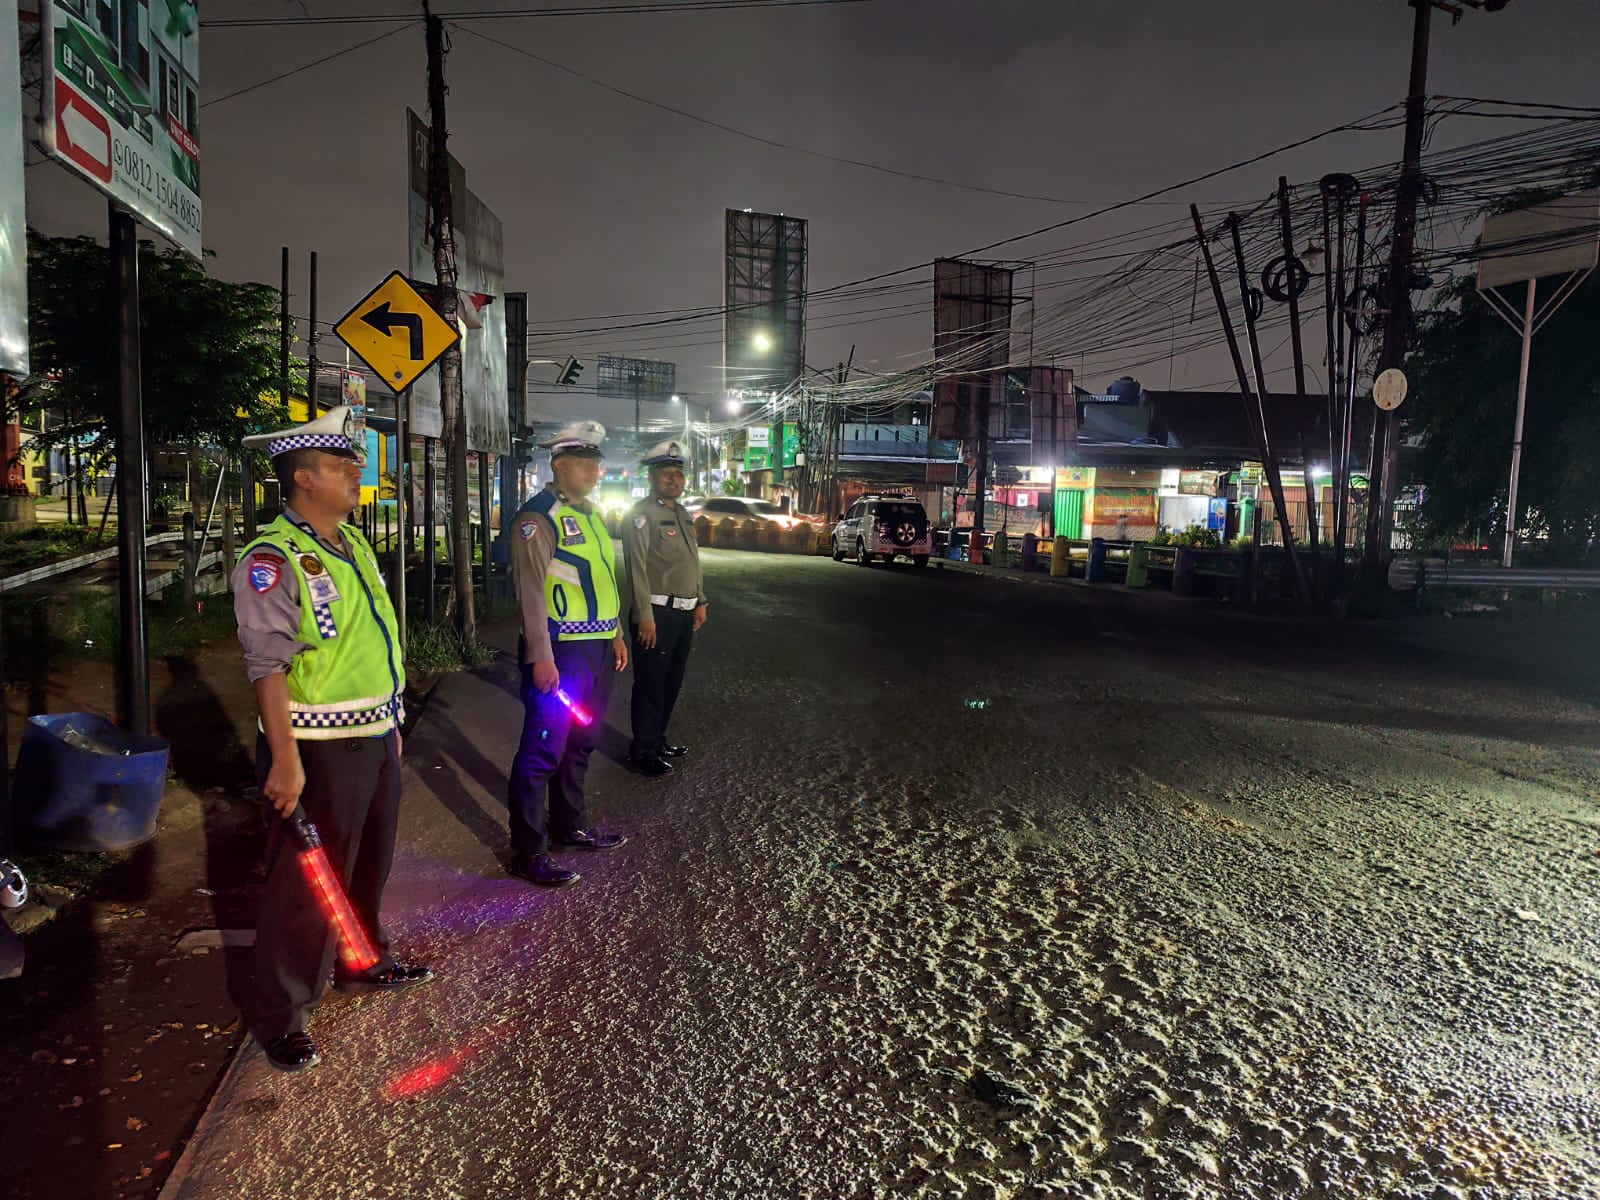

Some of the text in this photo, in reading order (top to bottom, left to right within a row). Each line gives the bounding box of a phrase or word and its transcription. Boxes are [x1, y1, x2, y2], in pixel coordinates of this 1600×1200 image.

[170, 119, 183, 143] UNIT
[124, 145, 152, 192] 0812
[156, 172, 179, 216] 1504
[181, 194, 201, 233] 8852
